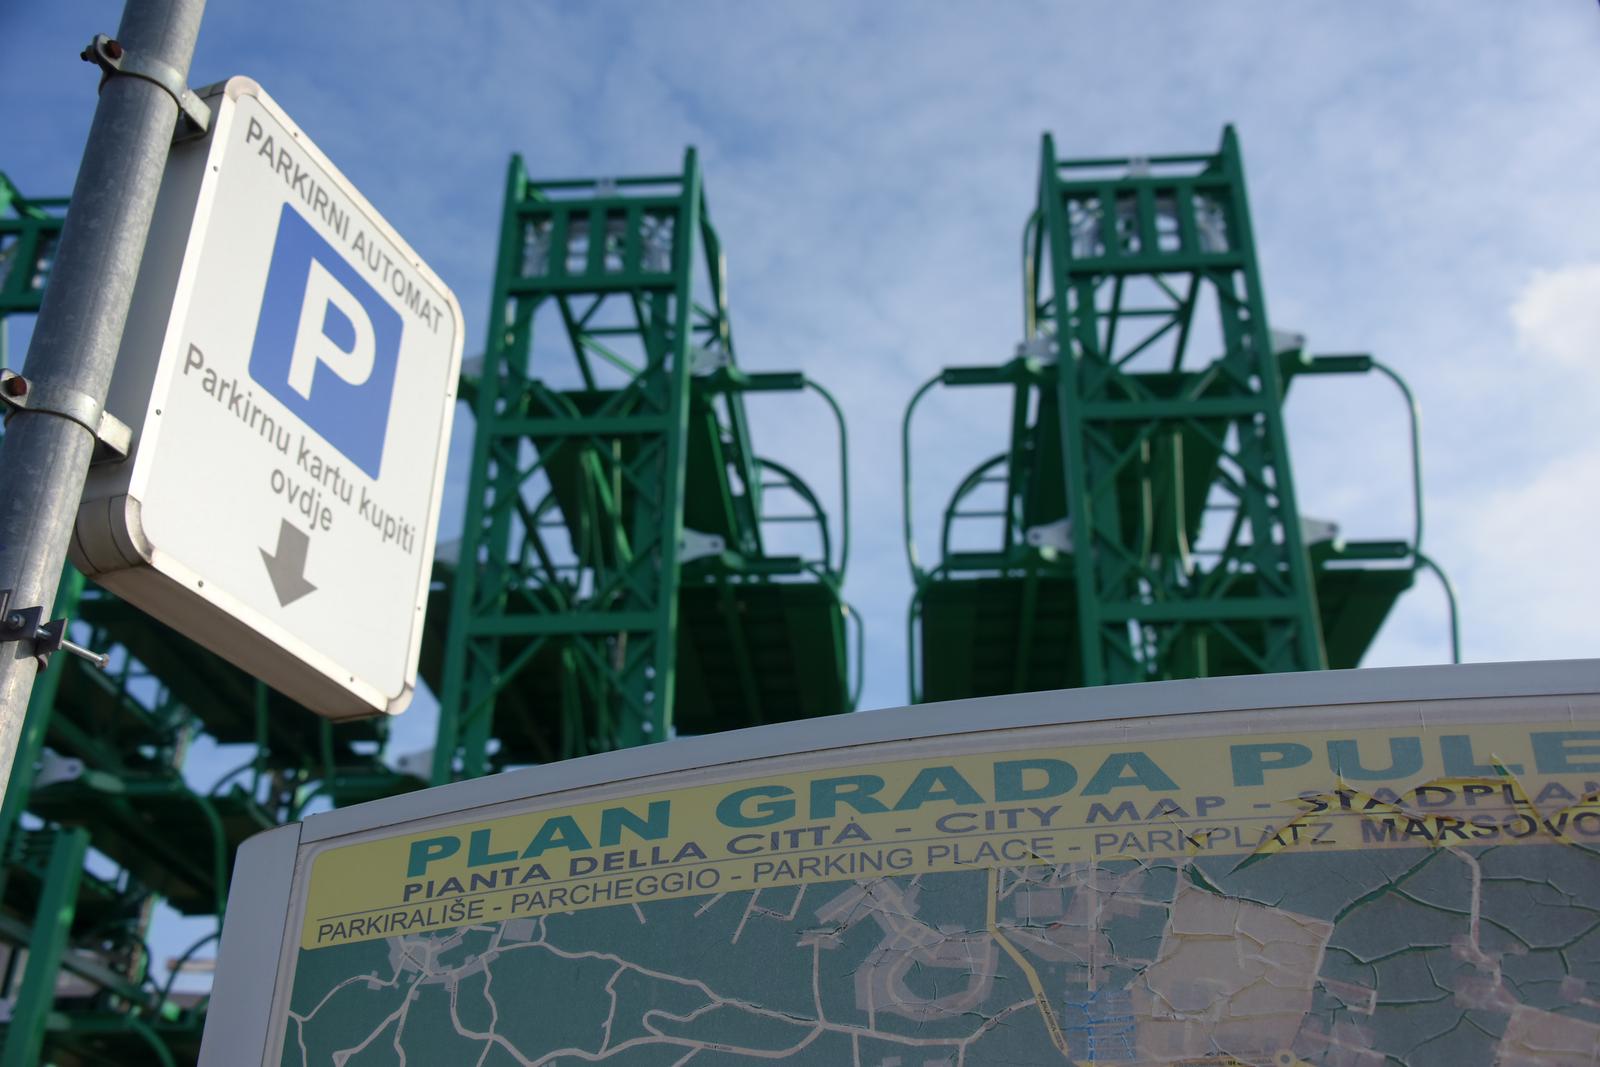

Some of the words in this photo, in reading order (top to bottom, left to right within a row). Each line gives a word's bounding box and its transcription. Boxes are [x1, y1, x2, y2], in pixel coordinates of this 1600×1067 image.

[245, 117, 349, 240] PARKIRNI
[352, 231, 444, 334] AUTOMAT
[287, 257, 376, 401] P
[184, 343, 289, 455] Parkirnu
[298, 436, 353, 506] kartu
[359, 491, 415, 555] kupiti
[271, 467, 333, 532] ovdje
[403, 864, 551, 903] PIANTA
[569, 841, 706, 877] DELLA
[726, 816, 872, 855] CITTÀ
[936, 804, 1062, 834] CITY
[1086, 796, 1226, 823] MAP
[407, 800, 671, 878] PLAN
[716, 752, 1180, 828] GRADA
[1231, 731, 1600, 787] PULE
[317, 898, 484, 943] PARKIRALIŠE
[511, 868, 720, 914] PARCHEGGIO
[753, 844, 913, 884] PARKING
[927, 836, 1055, 865] PLACE
[1094, 823, 1336, 855] PARKPLATZ
